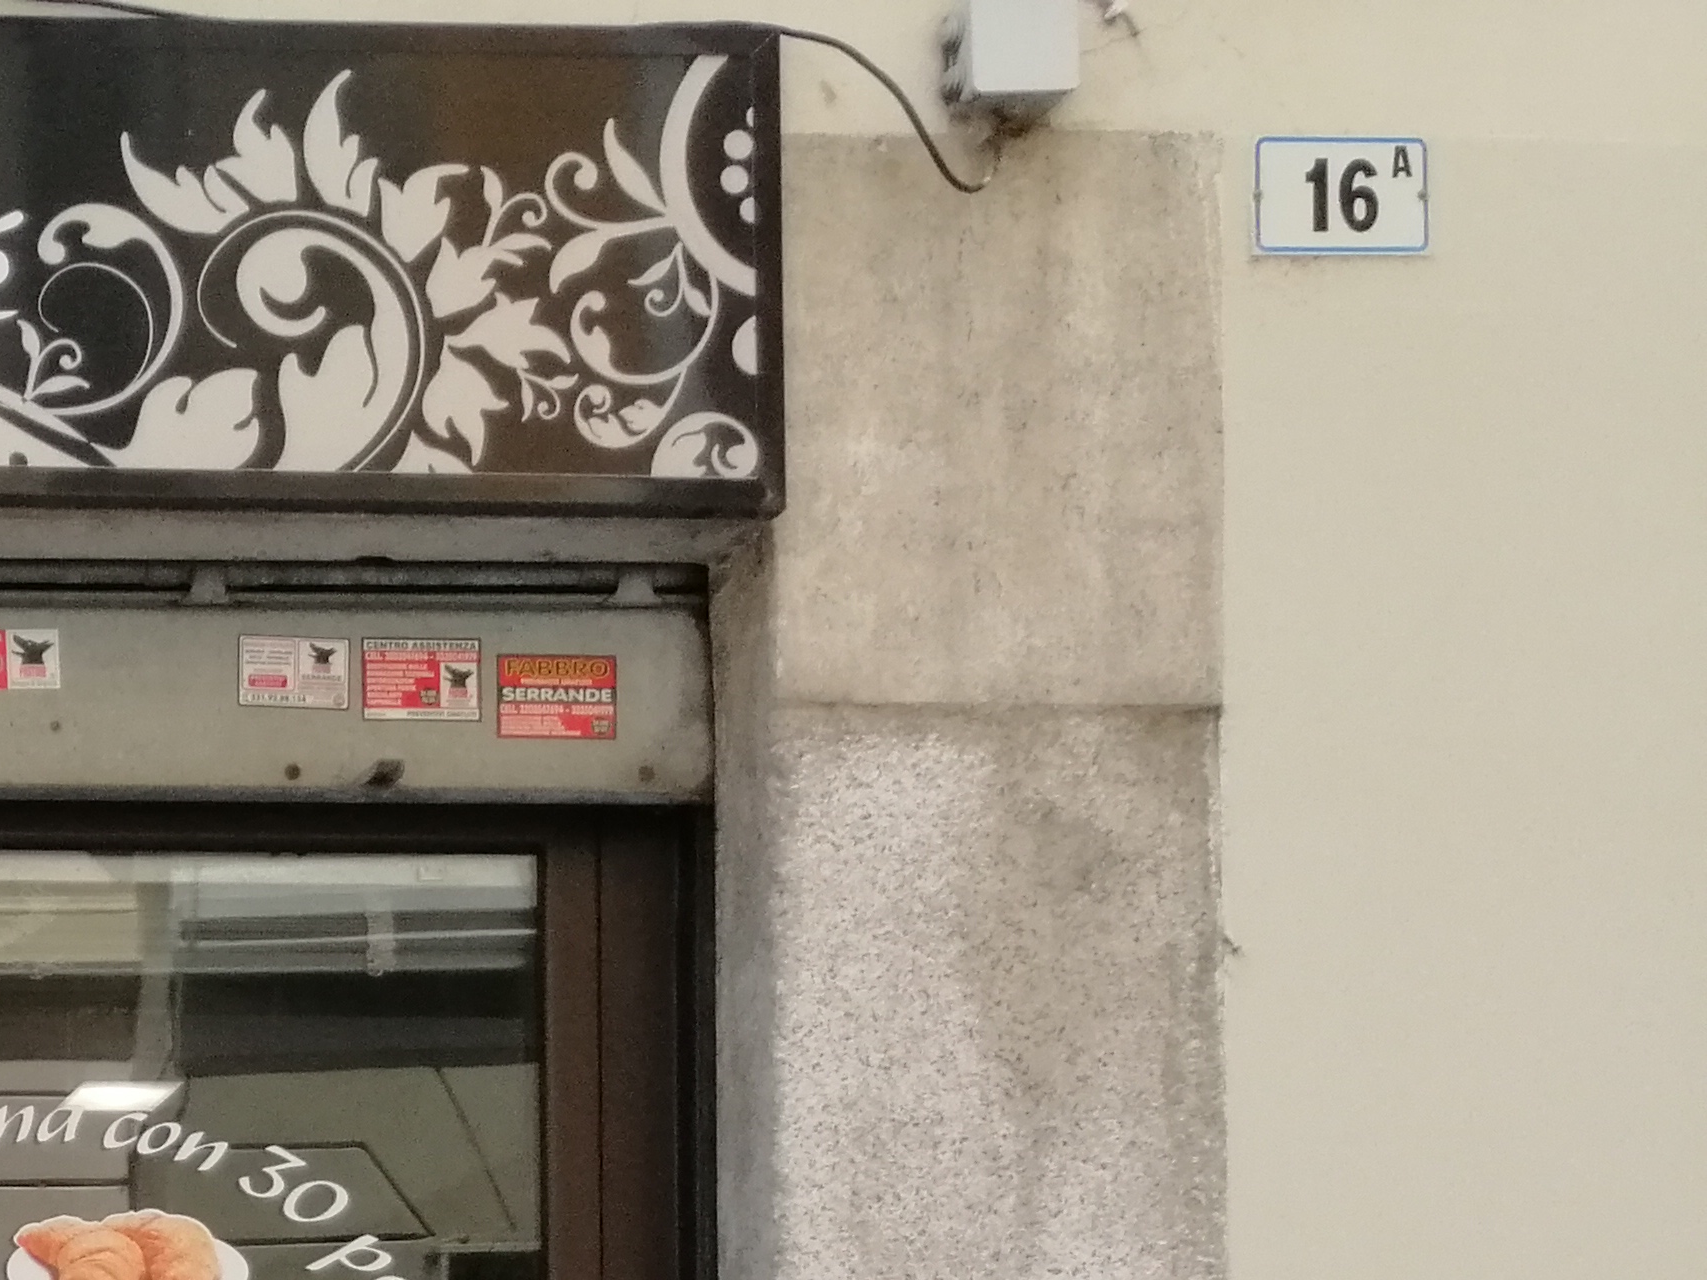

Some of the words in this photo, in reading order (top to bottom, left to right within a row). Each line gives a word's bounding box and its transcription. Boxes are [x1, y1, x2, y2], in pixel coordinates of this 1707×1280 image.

[1305, 157, 1379, 233] 16
[1391, 144, 1413, 178] A
[366, 641, 409, 649] CENTRO
[411, 641, 477, 650] ASSISTENZA
[504, 658, 610, 678] FABBRO
[501, 686, 612, 703] SERRANDE
[103, 1107, 229, 1172] con
[238, 1144, 350, 1223] 30
